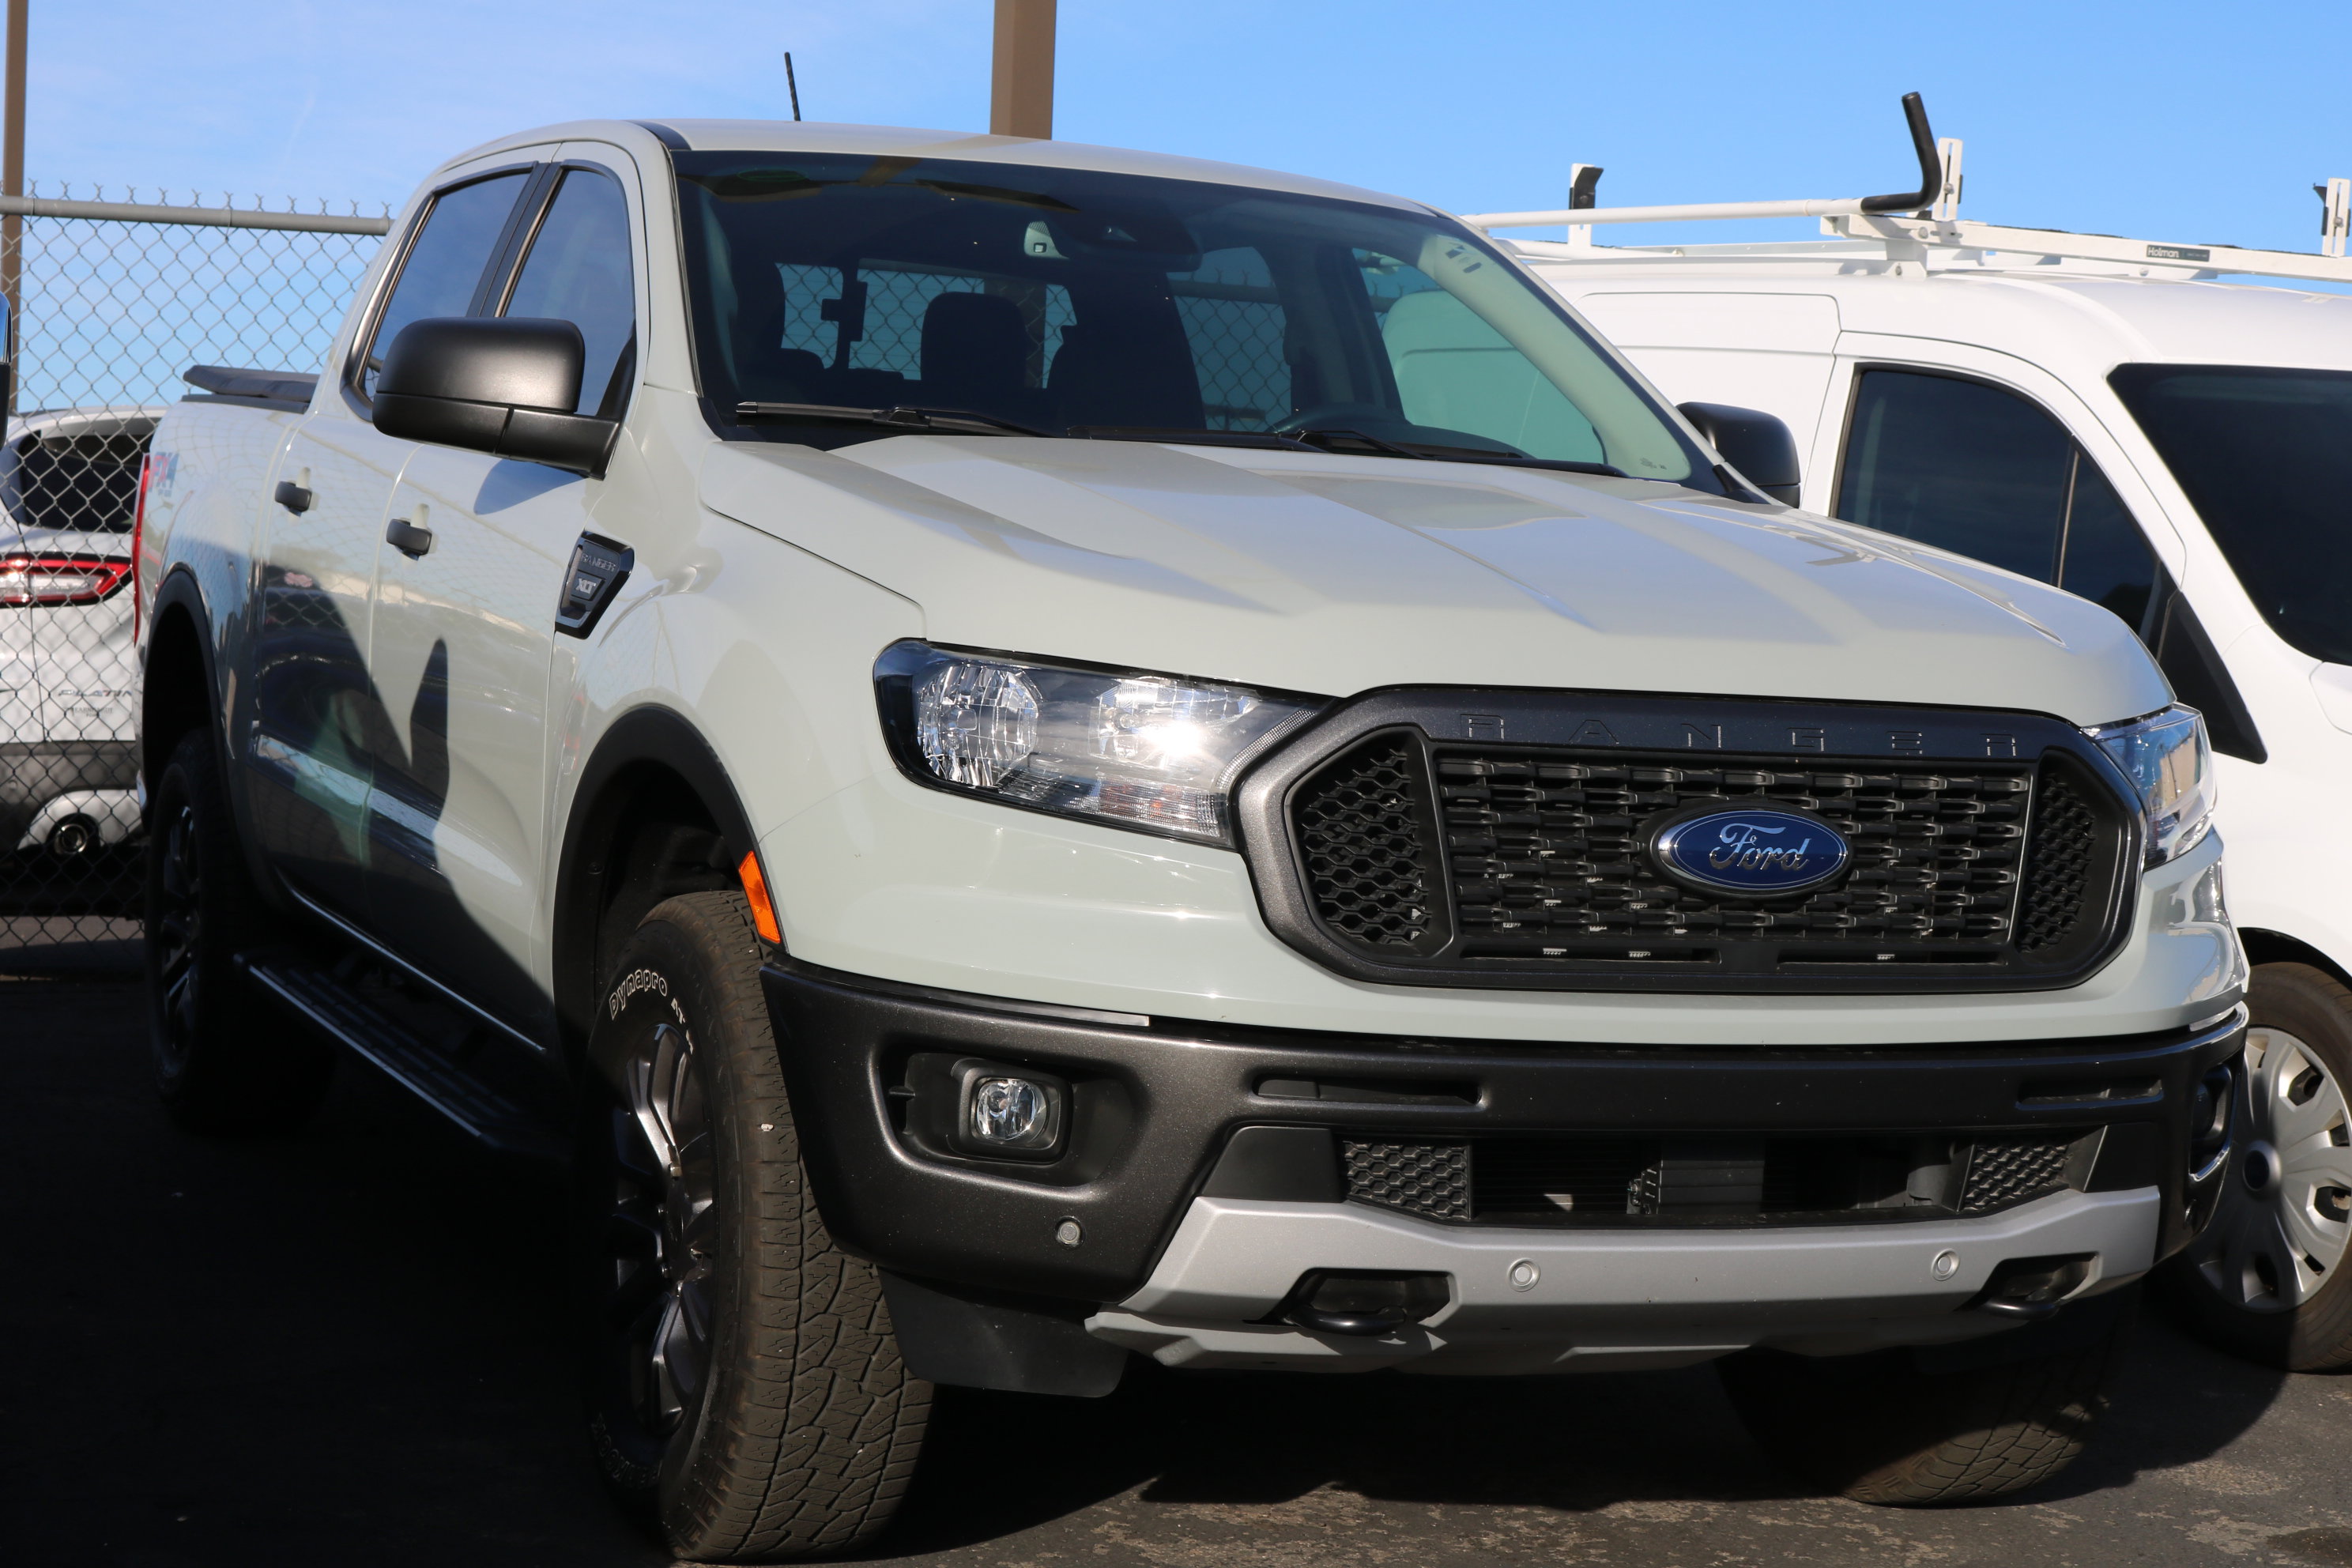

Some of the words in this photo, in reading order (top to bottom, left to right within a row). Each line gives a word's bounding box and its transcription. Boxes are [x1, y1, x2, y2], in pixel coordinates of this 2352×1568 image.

[581, 552, 616, 571] RANGER
[575, 578, 597, 594] XLT
[1461, 713, 2015, 756] RANGER
[1709, 823, 1811, 870] Ford
